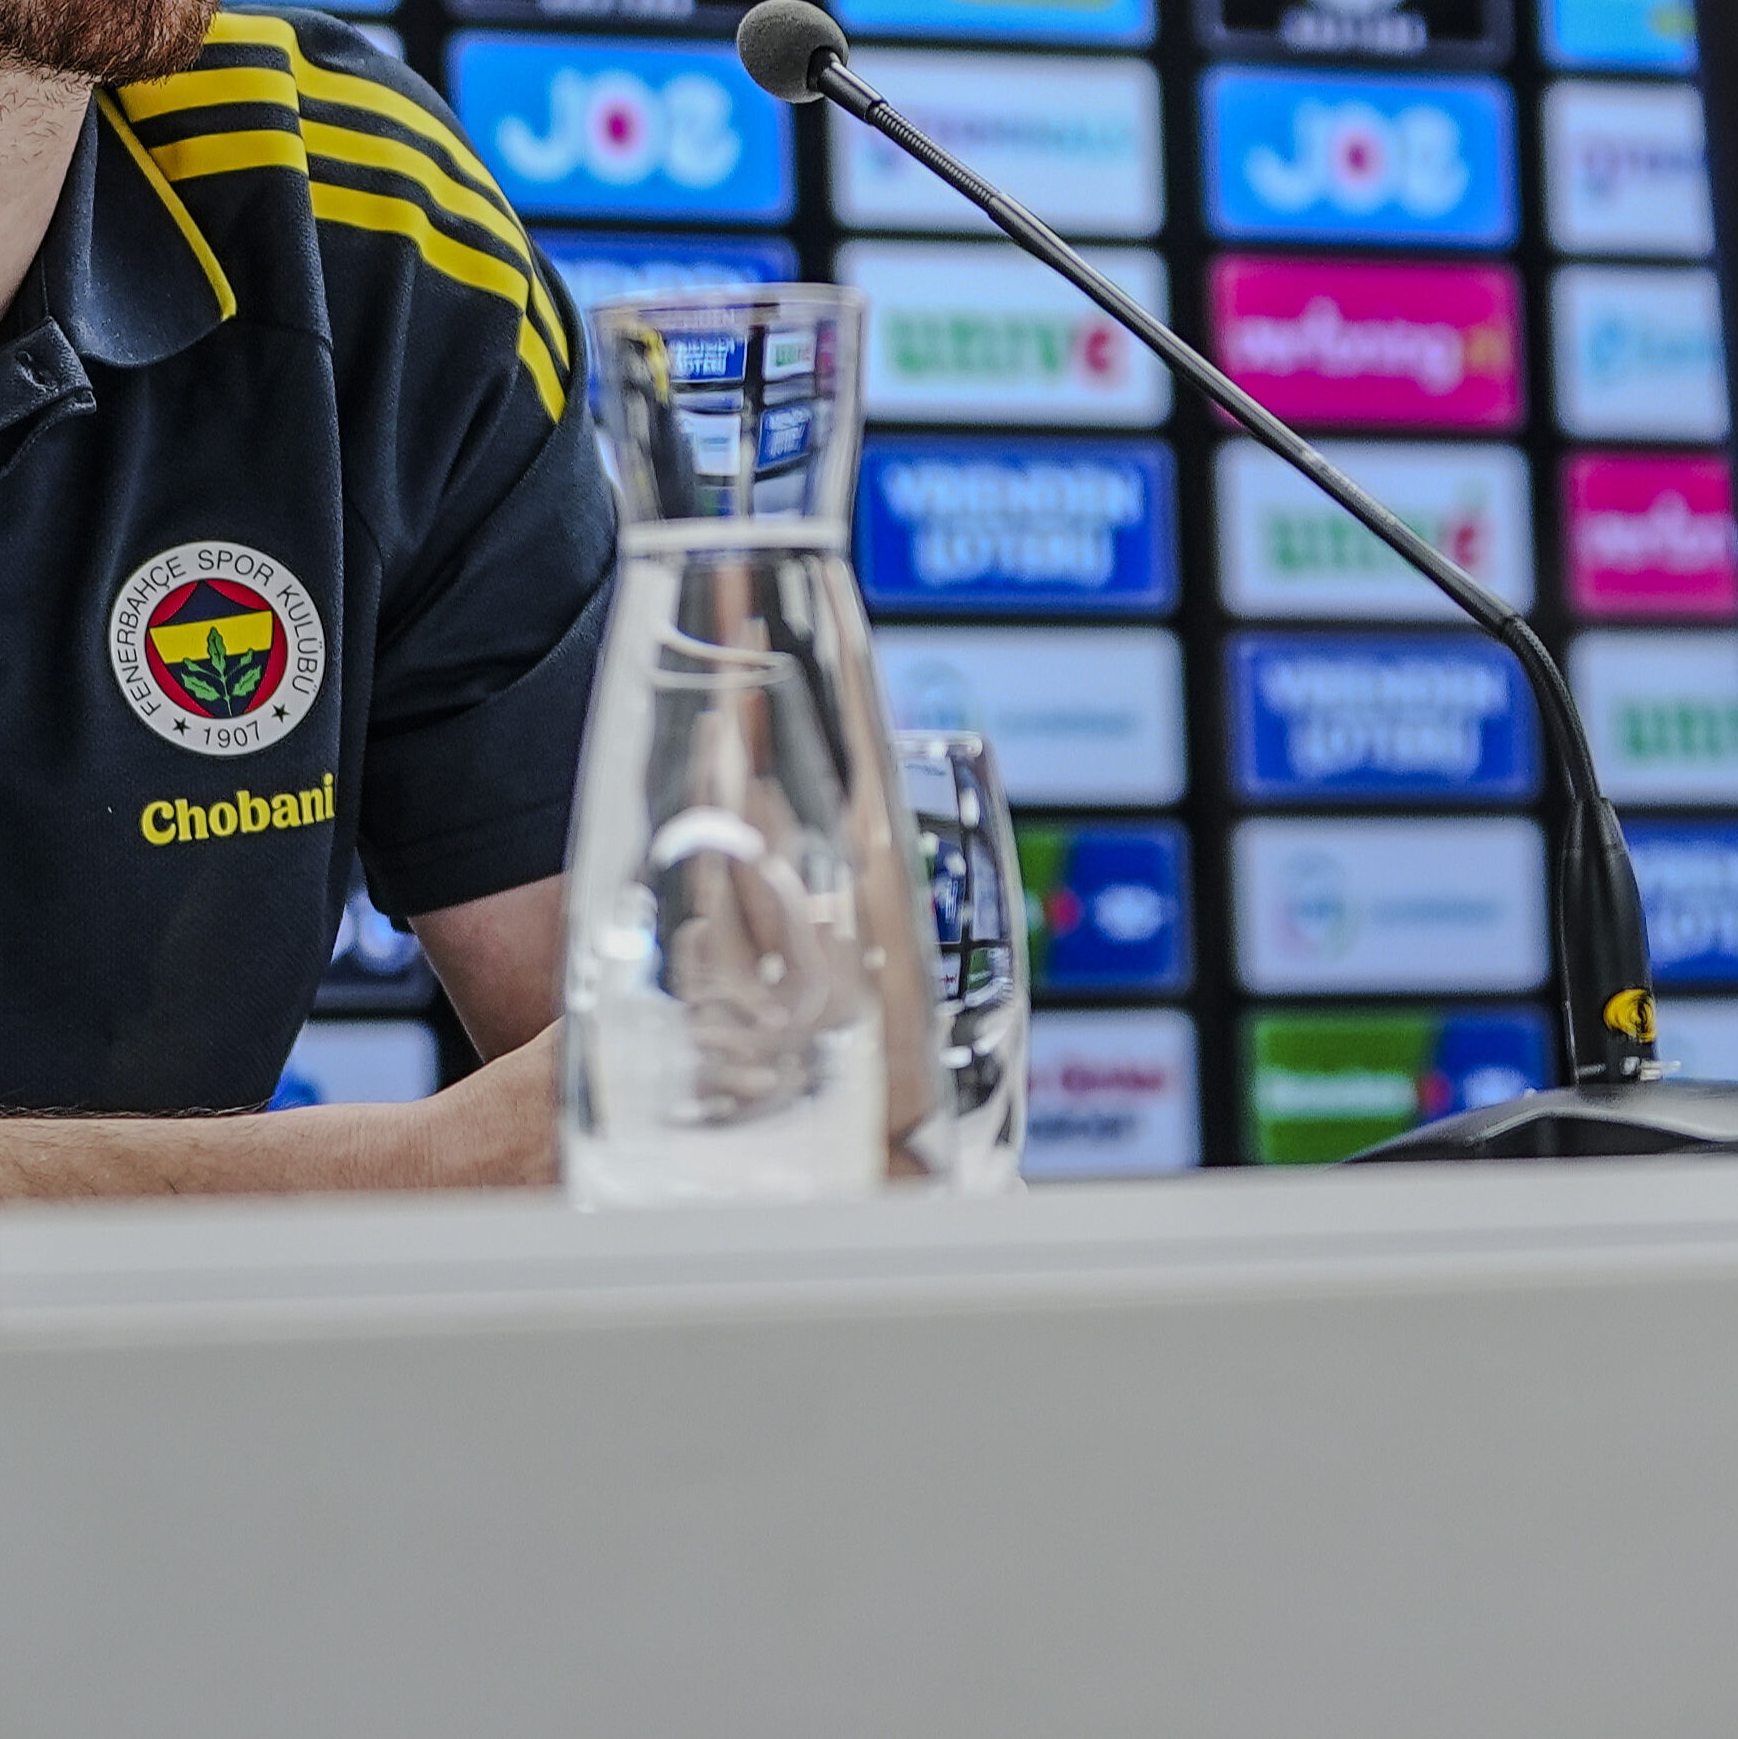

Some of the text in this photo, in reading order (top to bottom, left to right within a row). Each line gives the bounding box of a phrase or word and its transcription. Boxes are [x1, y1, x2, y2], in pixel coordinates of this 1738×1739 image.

[117, 548, 325, 719] FENERBAHÇE SPOR KULÜBÜ
[202, 719, 263, 749] 1907
[140, 772, 336, 846] Chobani
